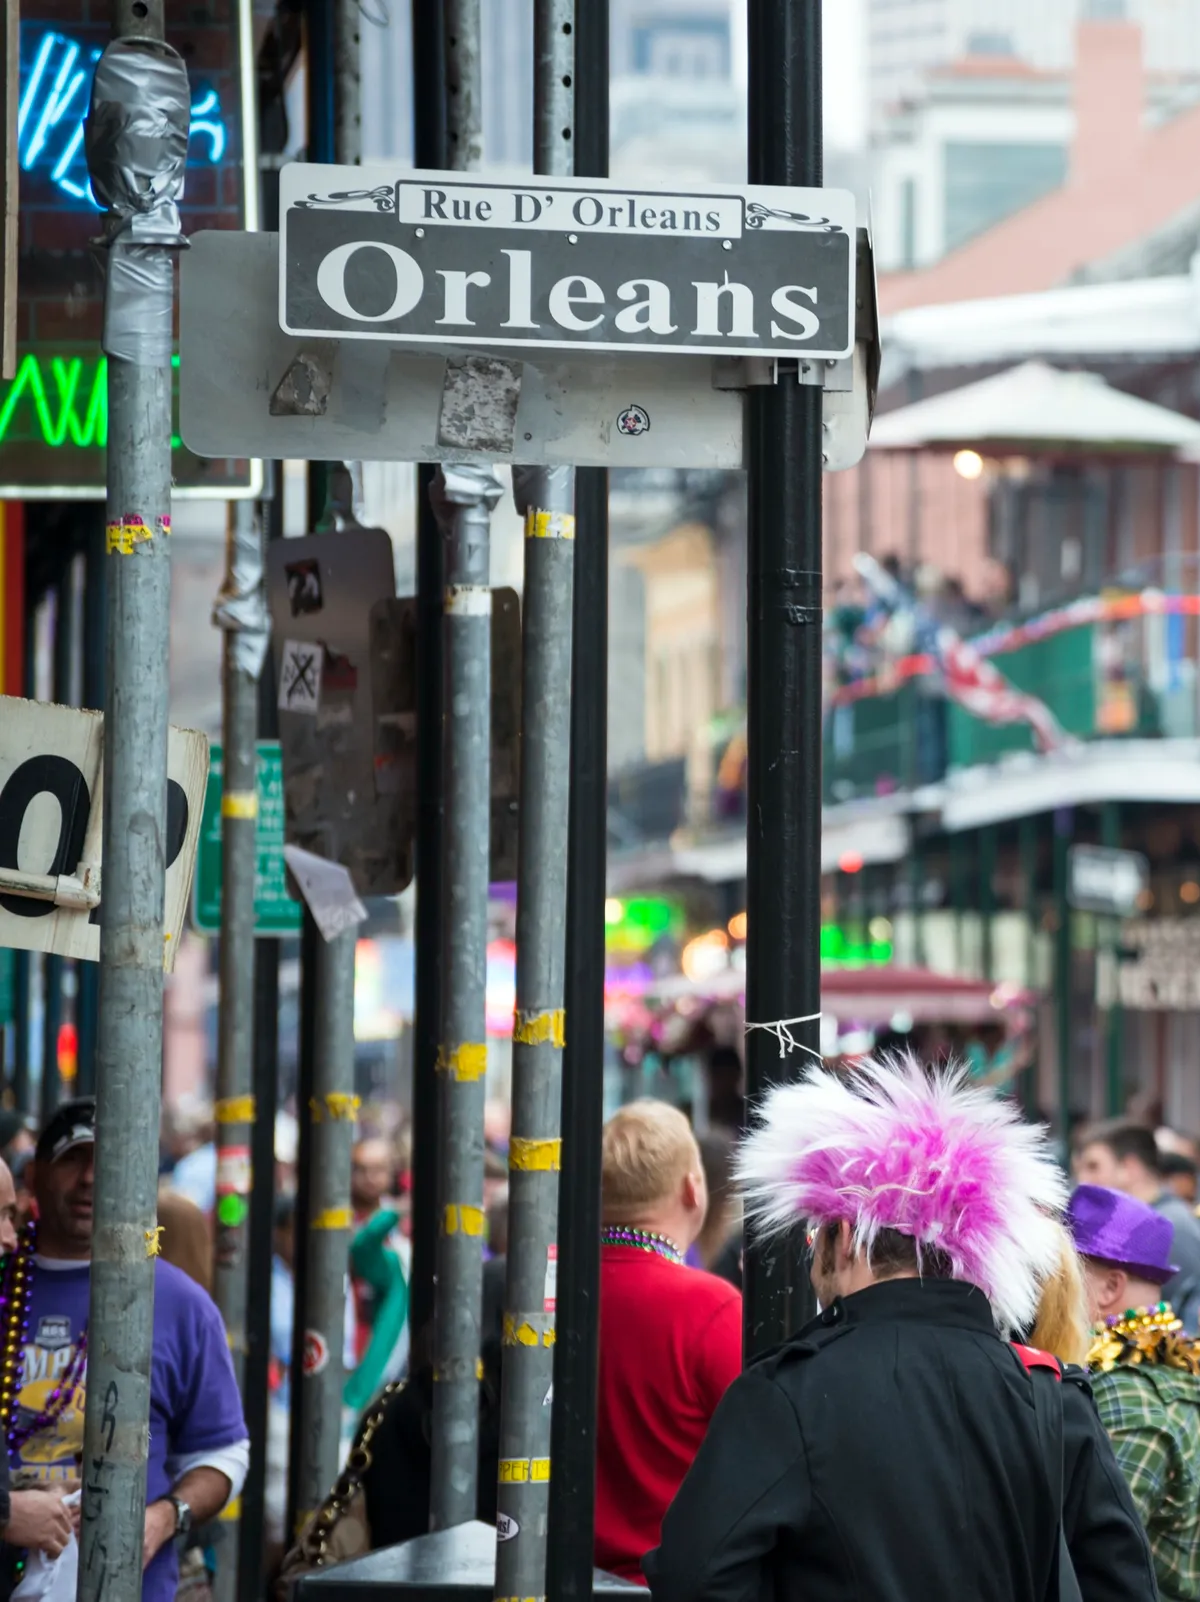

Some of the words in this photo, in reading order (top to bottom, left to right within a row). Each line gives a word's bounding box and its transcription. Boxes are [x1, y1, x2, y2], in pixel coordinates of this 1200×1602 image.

[422, 188, 493, 222] Rue
[512, 193, 553, 224] D'
[572, 196, 721, 232] Orleans
[316, 240, 822, 341] Orleans
